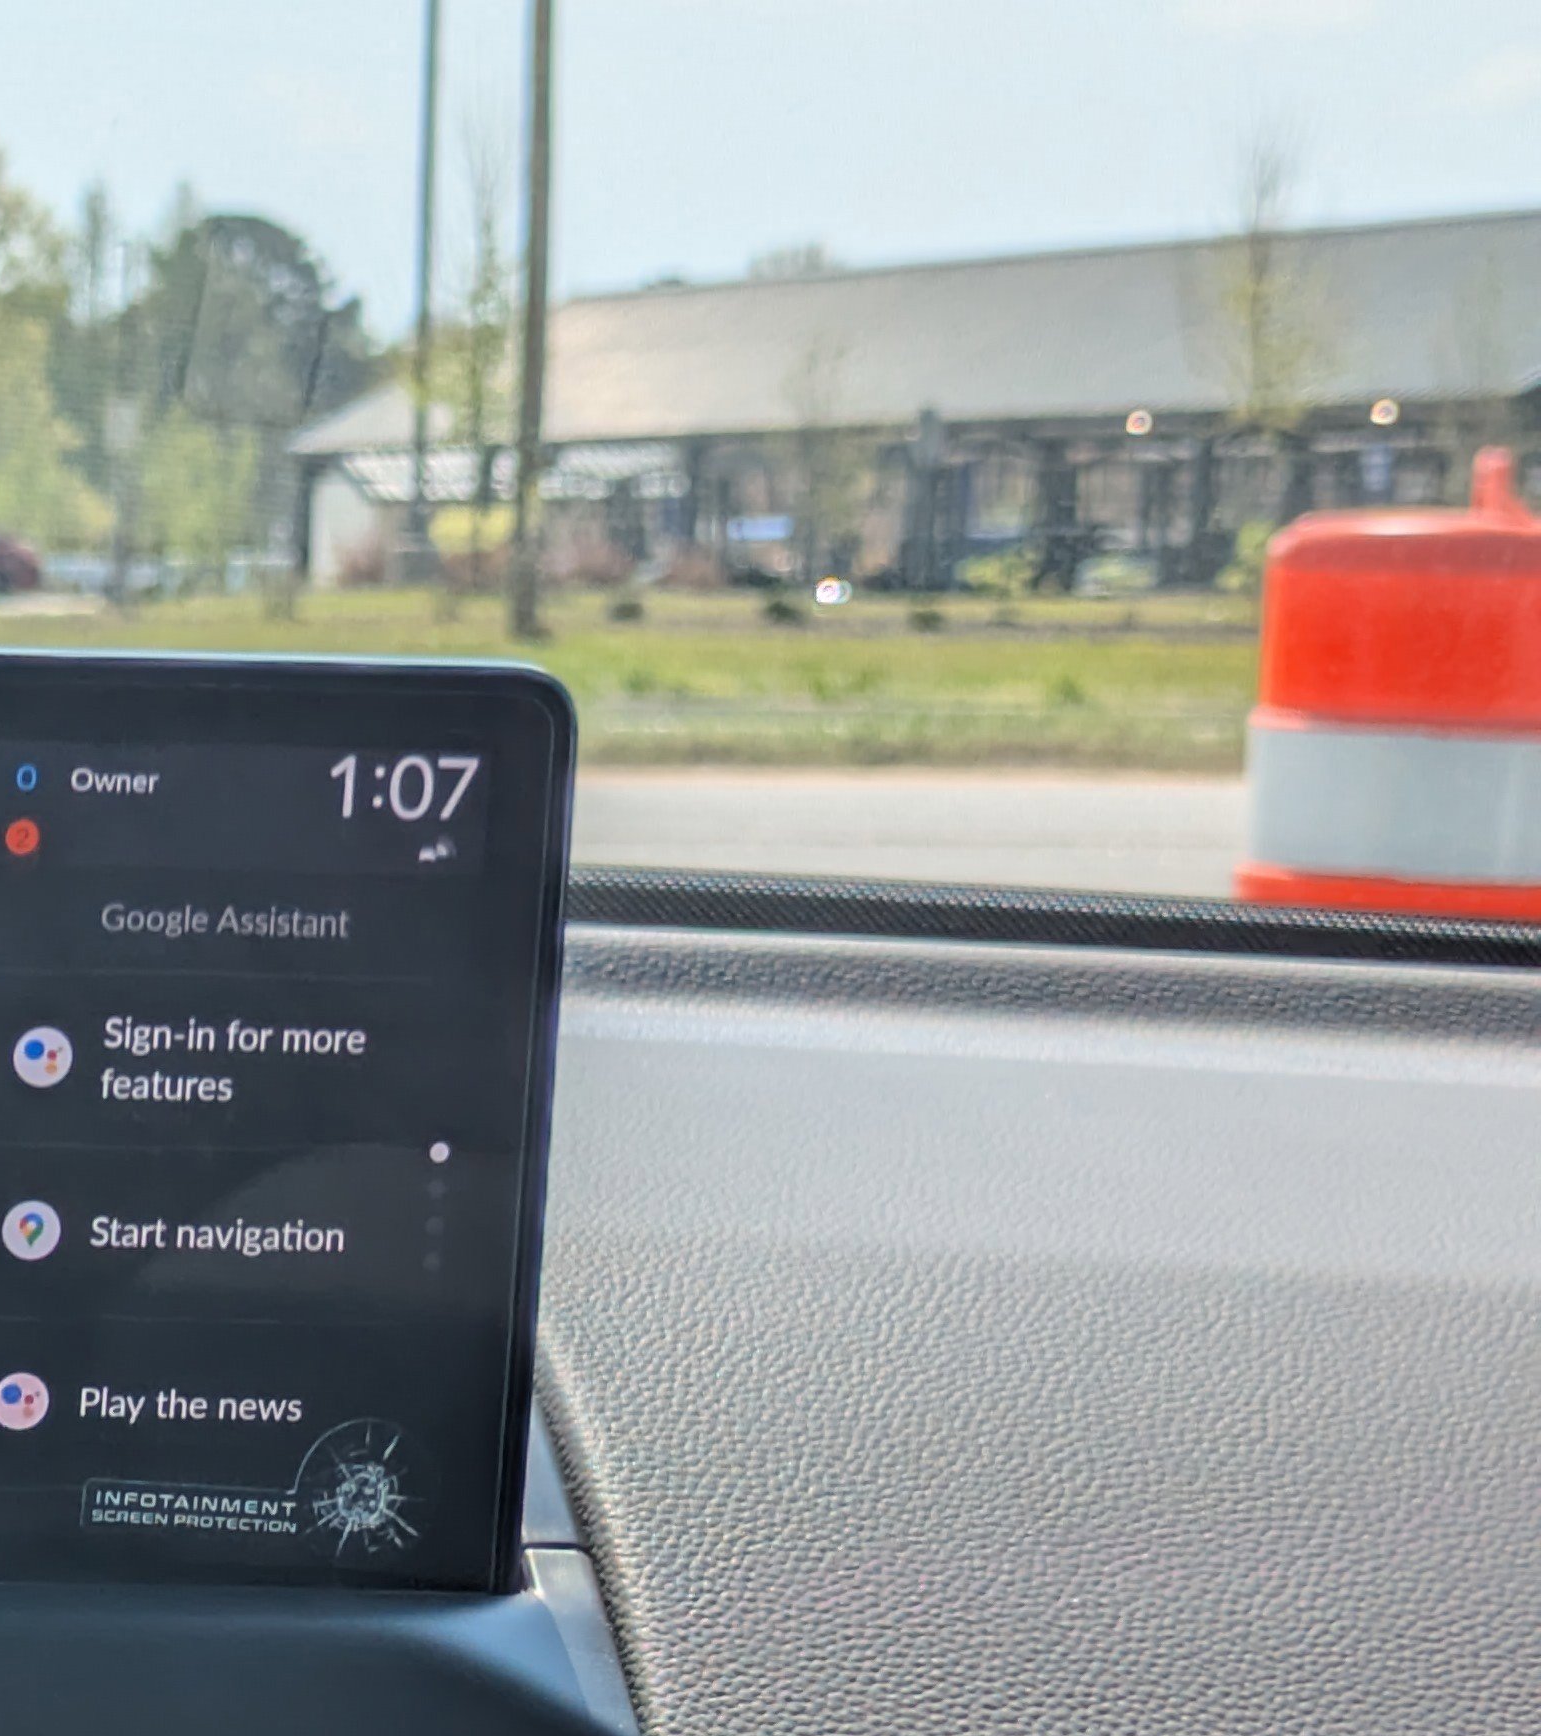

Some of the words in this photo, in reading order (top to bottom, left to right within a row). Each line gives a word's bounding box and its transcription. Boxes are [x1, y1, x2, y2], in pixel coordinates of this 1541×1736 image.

[71, 768, 159, 794] Owner
[330, 754, 480, 821] 1:07
[101, 902, 208, 937] Google
[216, 906, 349, 938] Assistant
[104, 1017, 215, 1056] Sign-in
[227, 1020, 273, 1052] for
[282, 1026, 367, 1055] more
[102, 1069, 233, 1102] features
[89, 1216, 167, 1248] Start
[177, 1218, 345, 1257] navigation
[80, 1387, 146, 1424] Play
[157, 1388, 208, 1421] the
[219, 1396, 302, 1422] news
[92, 1509, 167, 1525] SCREEN
[174, 1514, 297, 1534] PROTECTION
[96, 1490, 297, 1517] INFOTAINMENT
